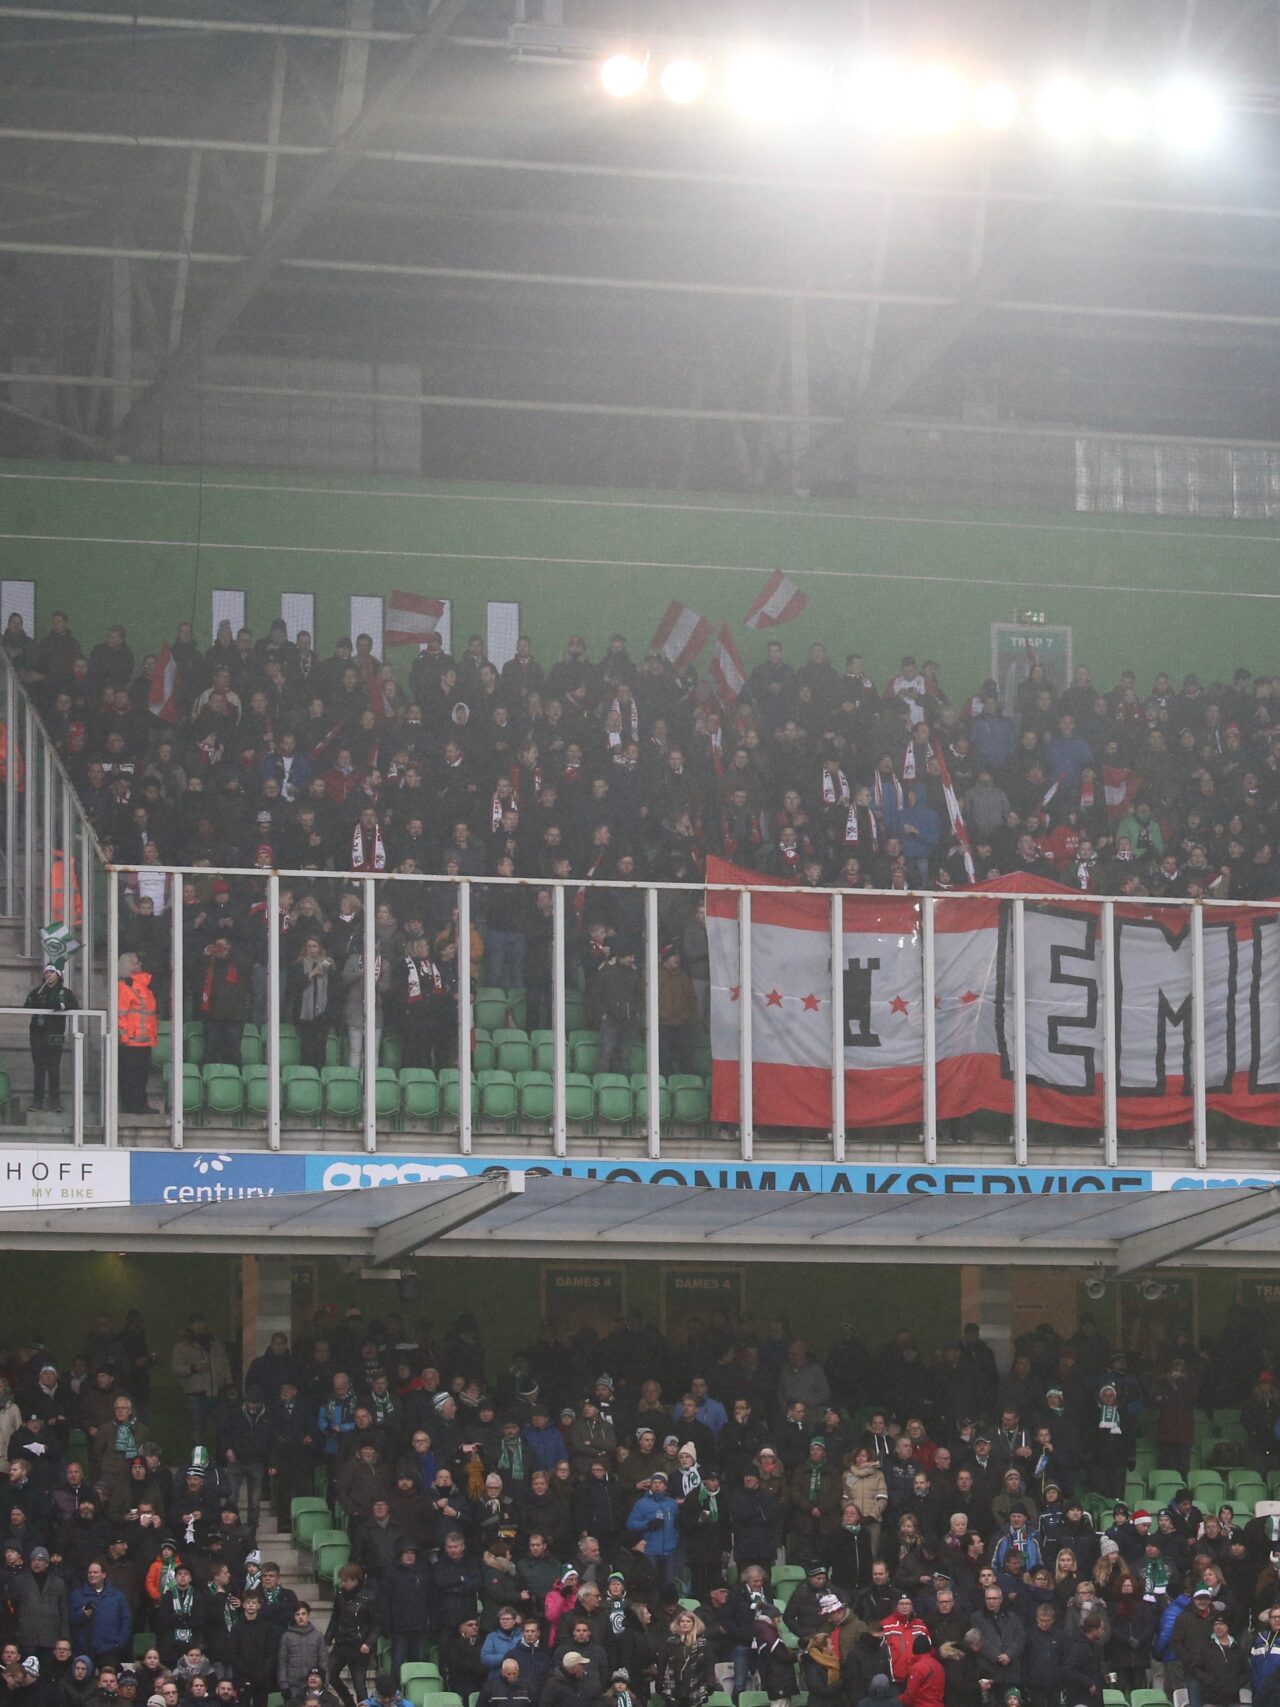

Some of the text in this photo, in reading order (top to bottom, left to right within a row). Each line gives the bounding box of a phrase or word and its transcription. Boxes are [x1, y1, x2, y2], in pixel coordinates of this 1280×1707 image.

[6, 1162, 94, 1181] HOFF
[31, 1188, 94, 1199] MY BIKE
[555, 1276, 600, 1288] DAMES
[675, 1278, 731, 1289] DAMES 4
